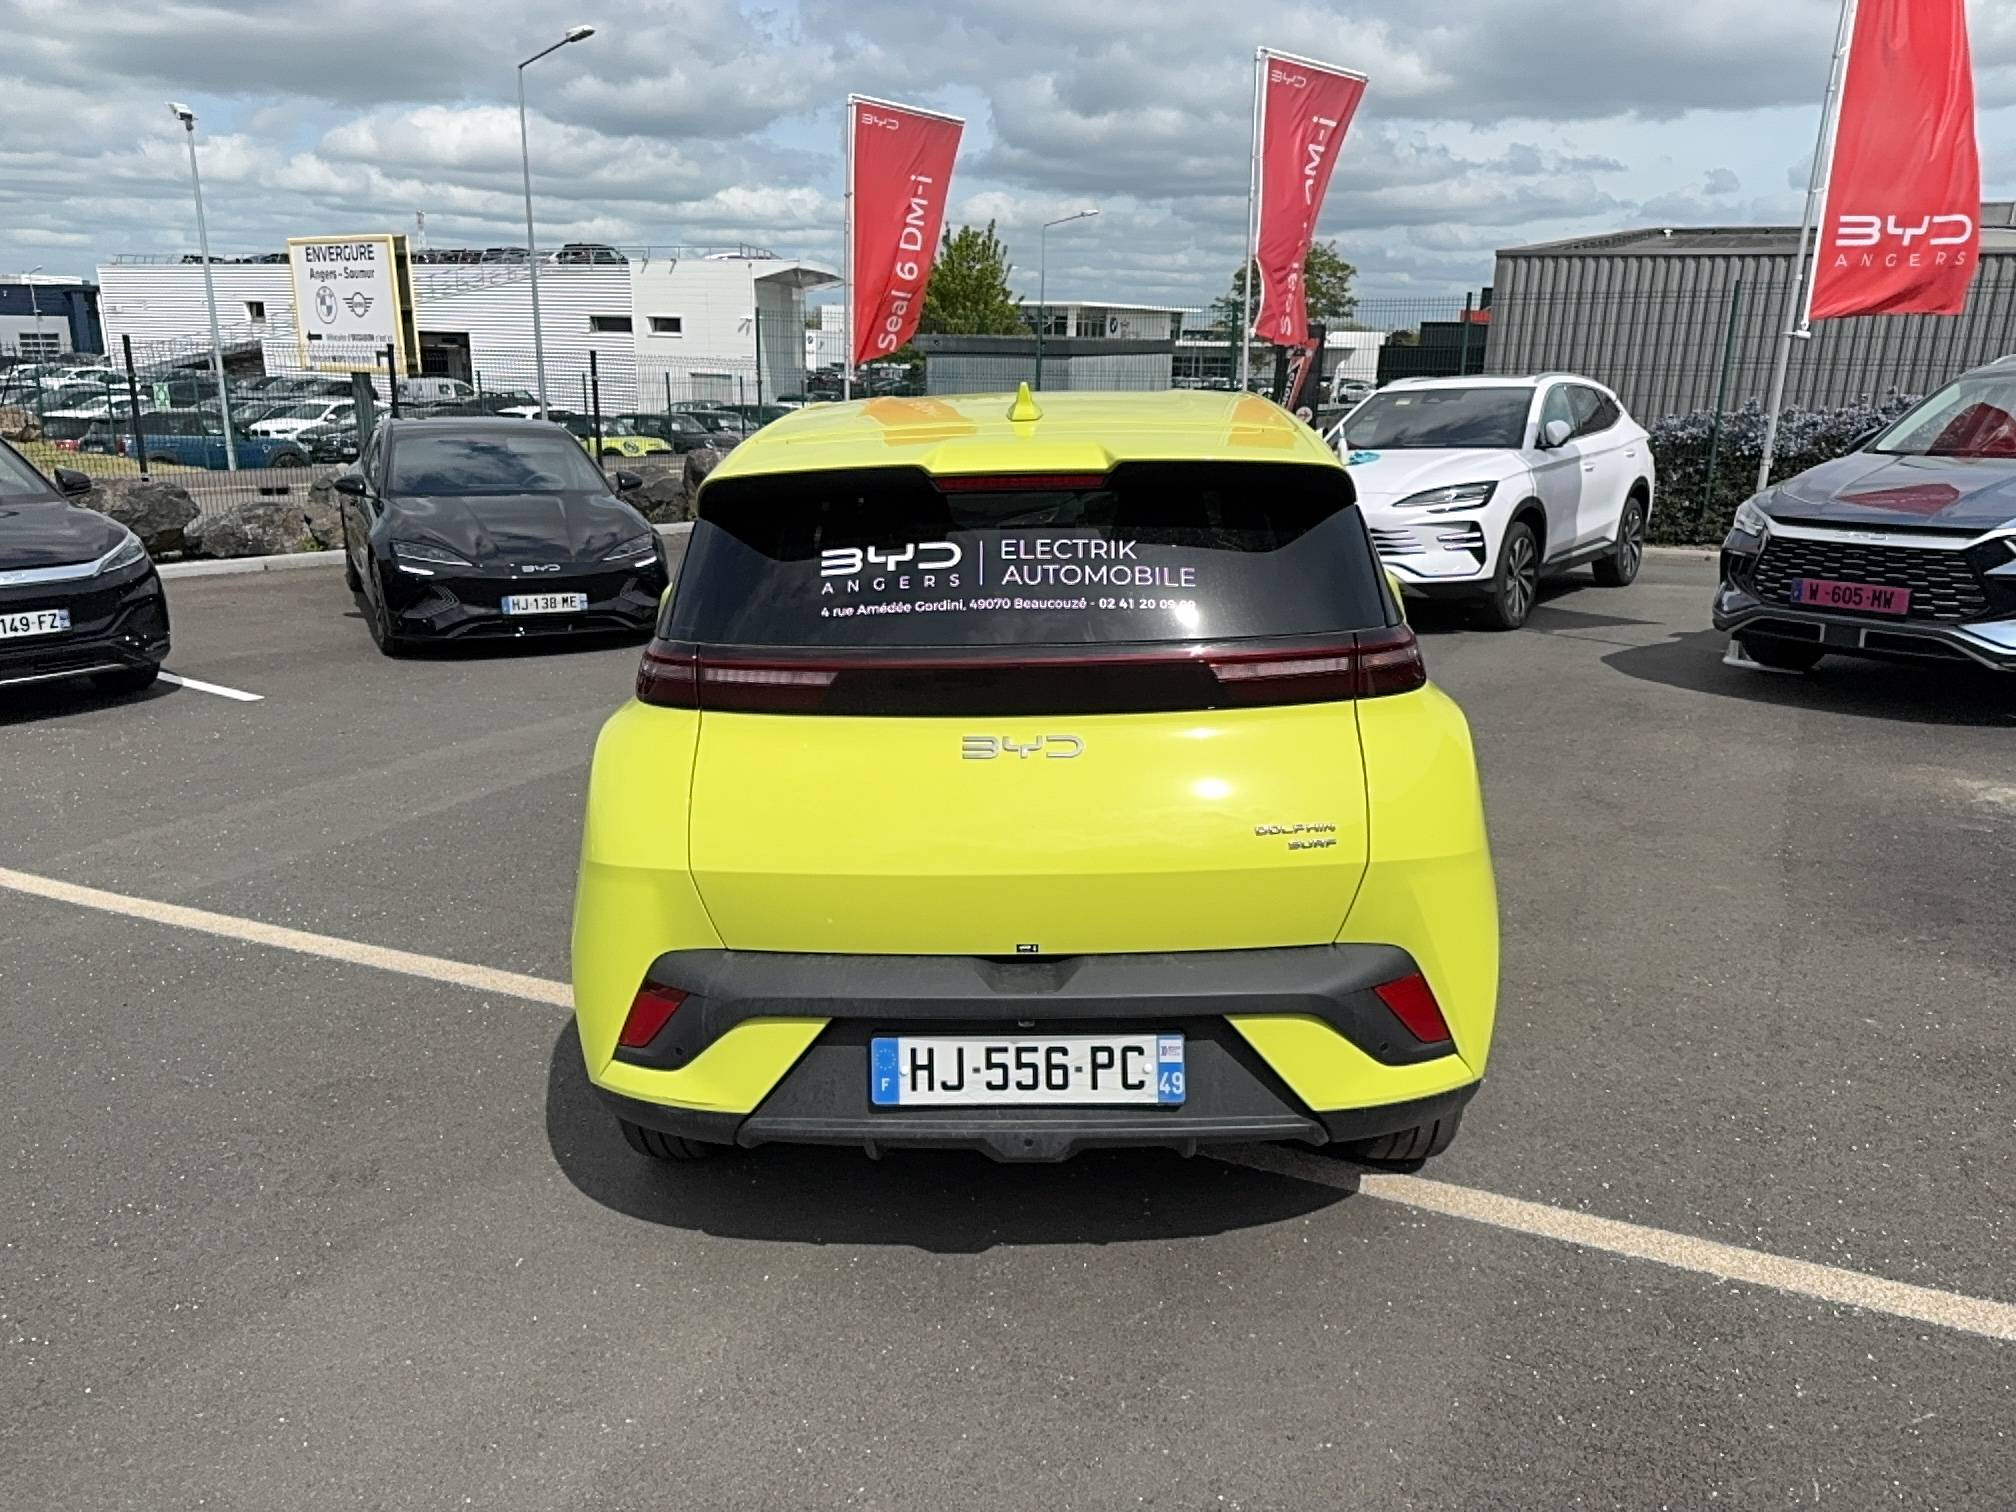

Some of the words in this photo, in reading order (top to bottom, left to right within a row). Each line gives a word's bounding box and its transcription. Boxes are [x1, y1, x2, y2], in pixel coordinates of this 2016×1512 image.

[1271, 69, 1307, 88] BYD
[861, 113, 899, 130] BYD
[900, 174, 933, 251] DM-i
[1835, 214, 1973, 246] BYD
[305, 244, 375, 262] ENVERGURE
[1835, 251, 1966, 267] ANGERS
[310, 267, 337, 282] Angers
[896, 261, 918, 280] 6
[878, 288, 913, 351] Seal
[821, 541, 962, 577] BYD
[1000, 539, 1138, 560] ELECTRIK
[821, 573, 961, 596] ANGERS
[1001, 565, 1197, 587] AUTOMOBILE
[821, 606, 830, 618] 4
[833, 606, 853, 617] rue
[969, 598, 1012, 610] 49070
[1014, 597, 1087, 610] Beaucouzé
[1099, 598, 1116, 609] 02
[1119, 598, 1134, 609] 41
[1139, 599, 1156, 609] 20
[962, 735, 1084, 759] BYD
[1255, 823, 1336, 836] DOLPHIN
[1287, 838, 1336, 850] SURF
[909, 1046, 1146, 1091] HJ-556-PC
[881, 1077, 890, 1091] F
[1159, 1071, 1184, 1094] 49
